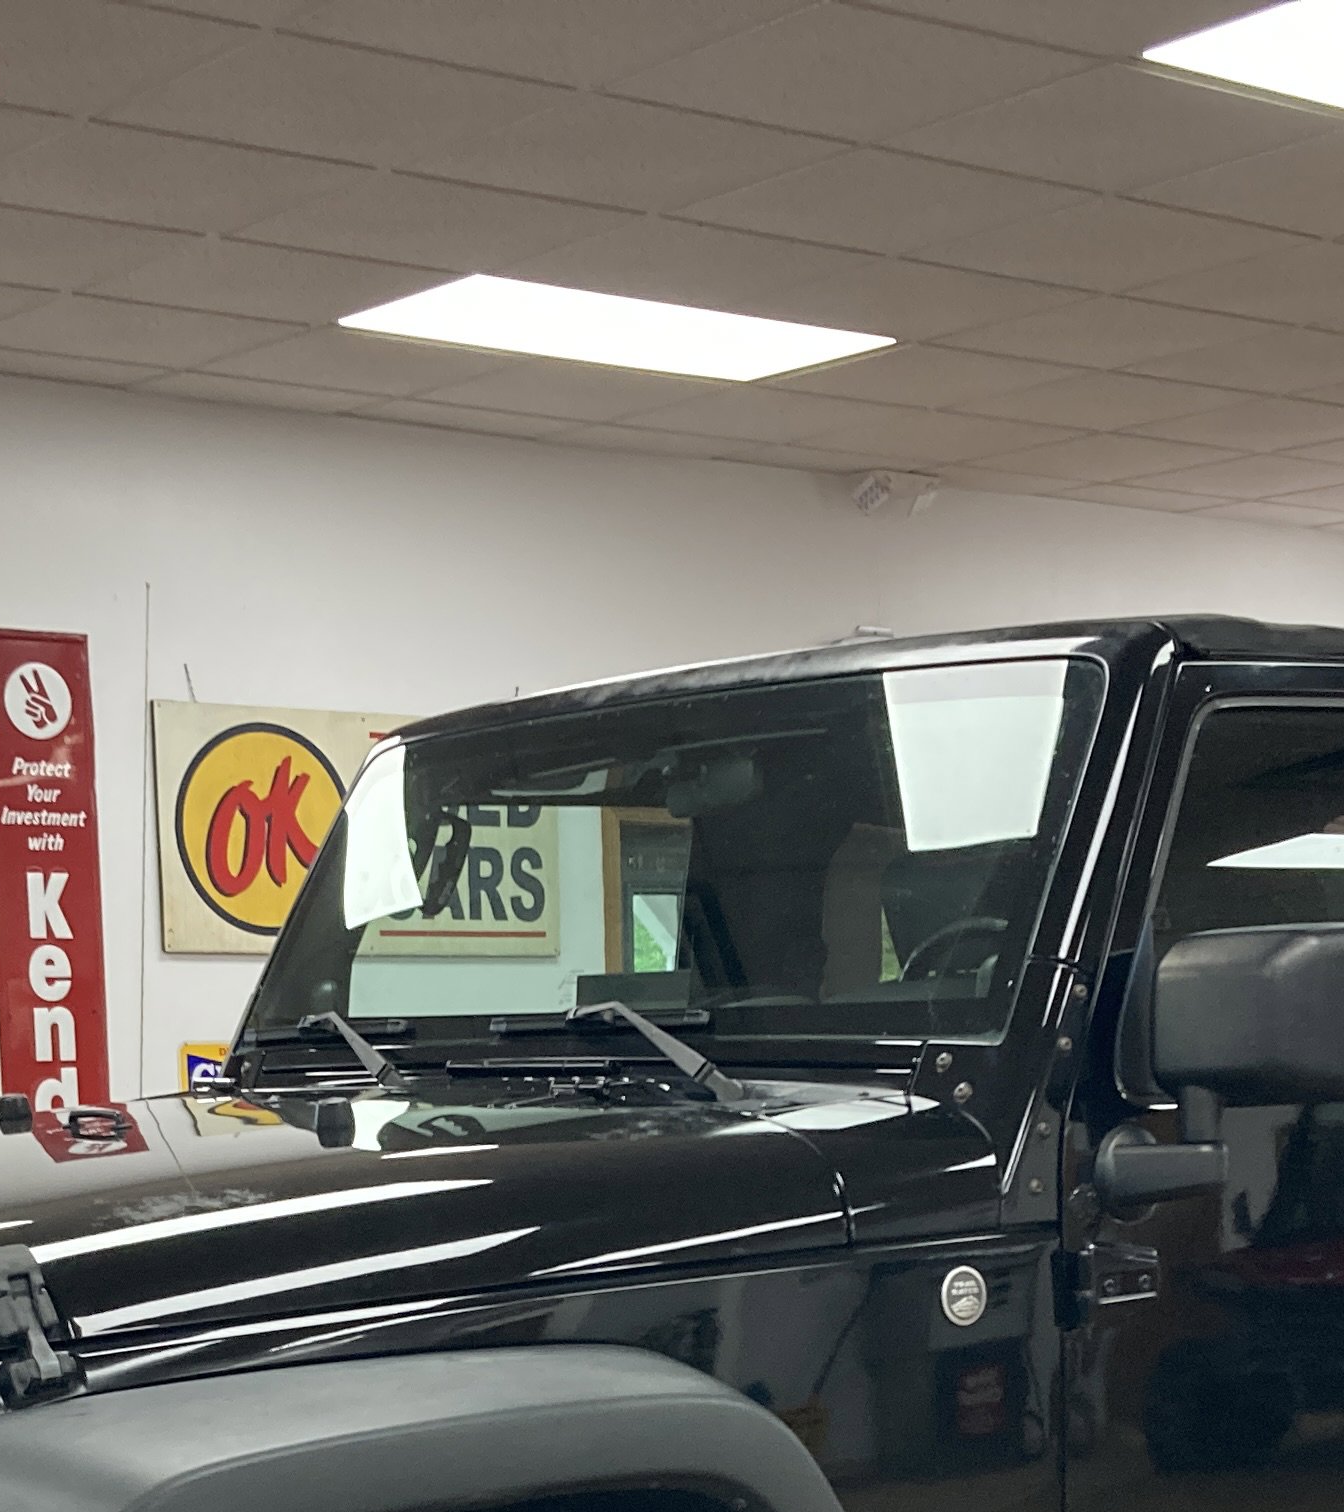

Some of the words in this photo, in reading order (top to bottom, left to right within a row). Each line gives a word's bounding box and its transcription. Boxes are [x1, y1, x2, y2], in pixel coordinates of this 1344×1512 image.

[11, 756, 72, 778] Protect
[27, 783, 62, 803] Your
[0, 805, 88, 828] Investment
[205, 755, 320, 898] OK
[27, 832, 65, 852] with
